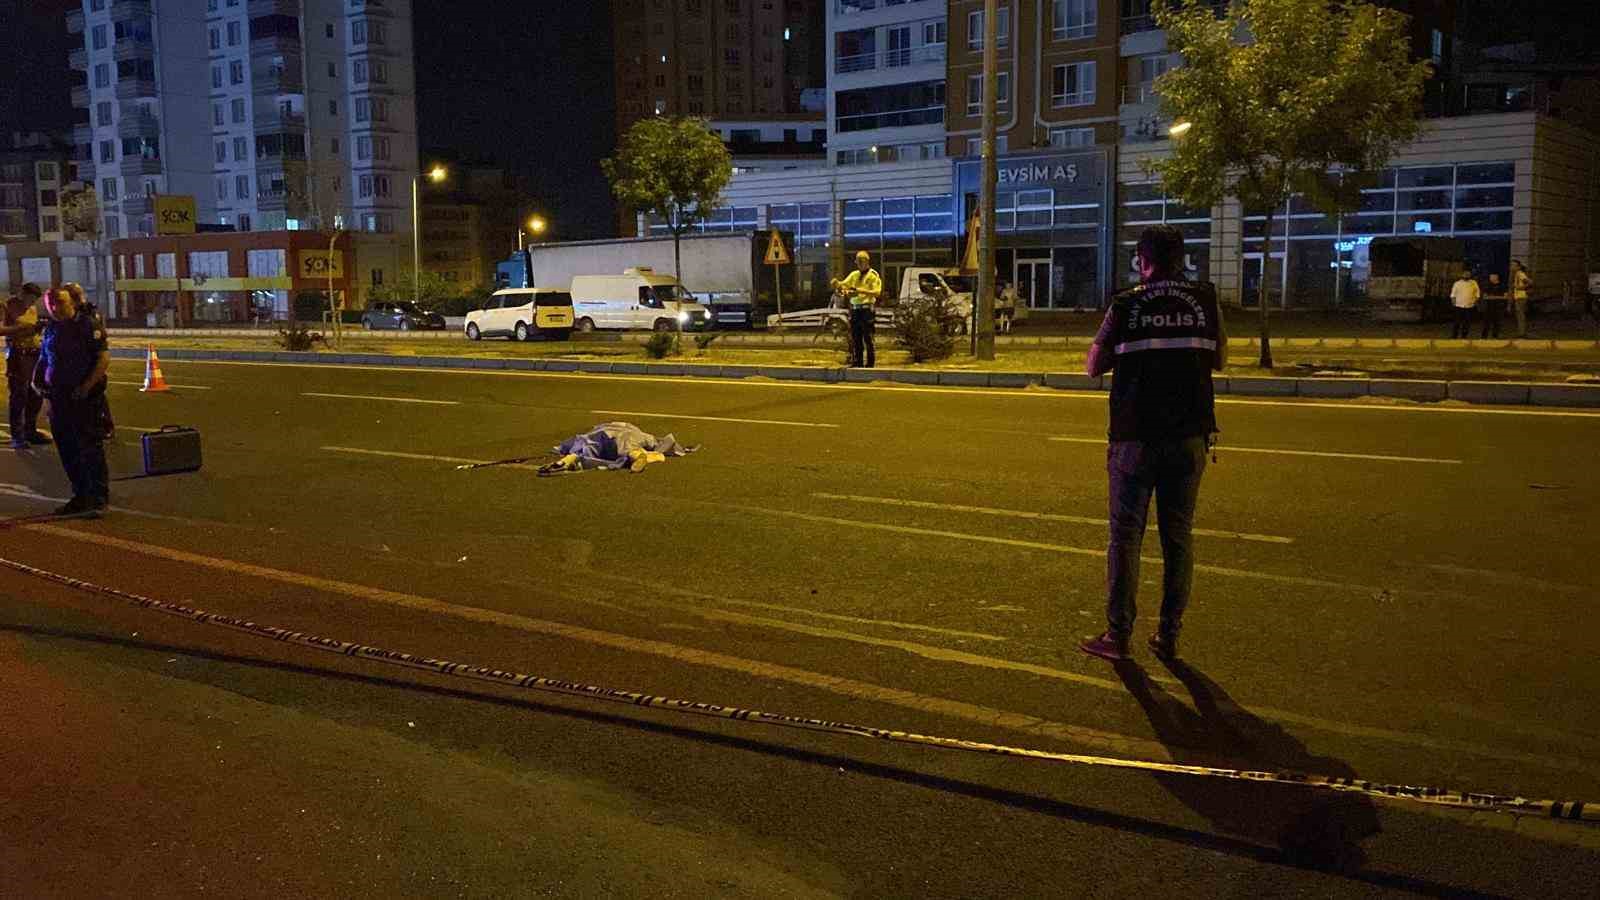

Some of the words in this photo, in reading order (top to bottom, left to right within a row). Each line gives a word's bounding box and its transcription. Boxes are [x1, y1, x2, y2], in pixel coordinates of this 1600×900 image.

[996, 163, 1049, 183] EVSİM
[1053, 163, 1078, 183] AŞ
[1140, 312, 1195, 328] POLİS
